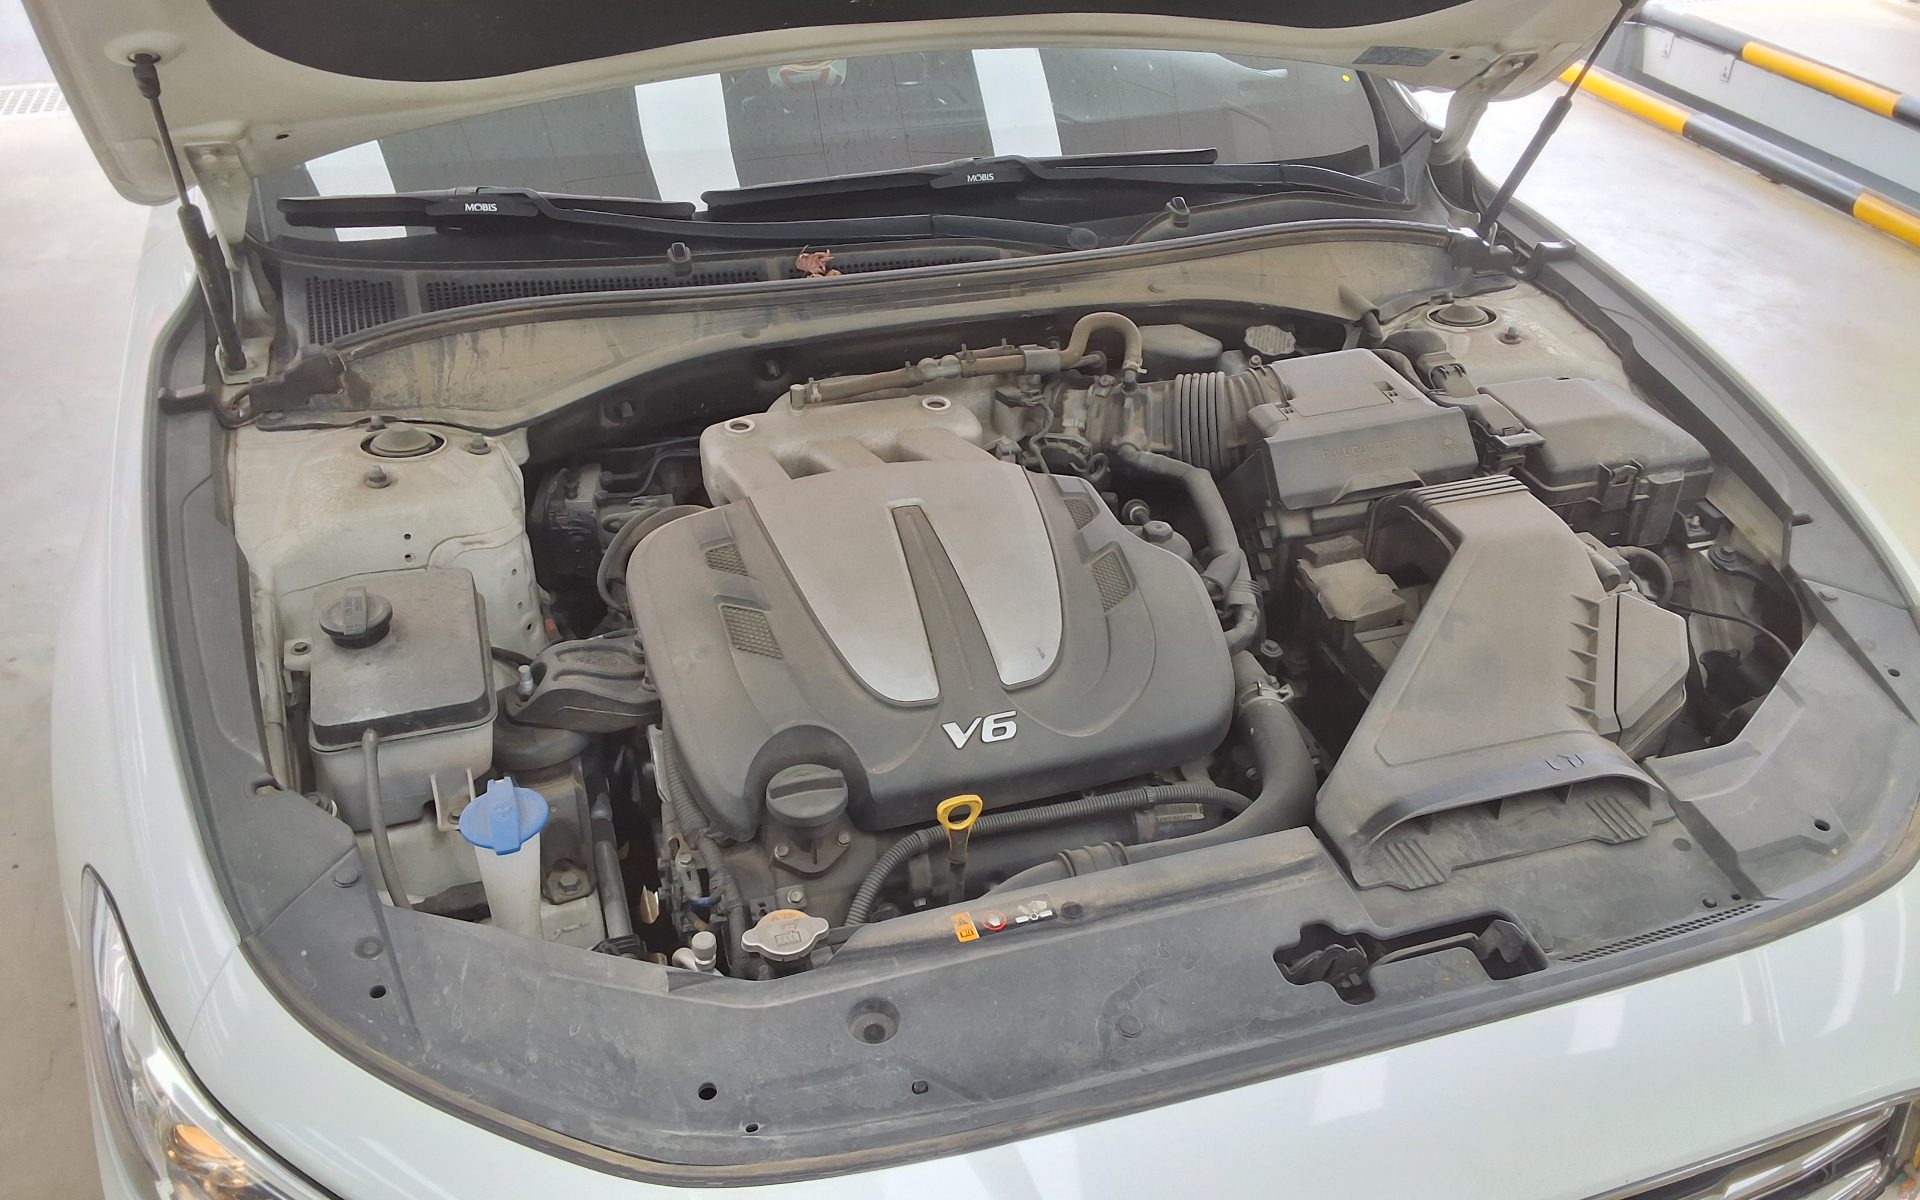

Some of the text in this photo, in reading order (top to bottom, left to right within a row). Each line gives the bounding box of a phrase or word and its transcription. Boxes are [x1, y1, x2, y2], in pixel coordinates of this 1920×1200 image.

[967, 173, 995, 182] MOBIS
[464, 203, 498, 212] MOBIS
[942, 710, 1018, 750] V6
